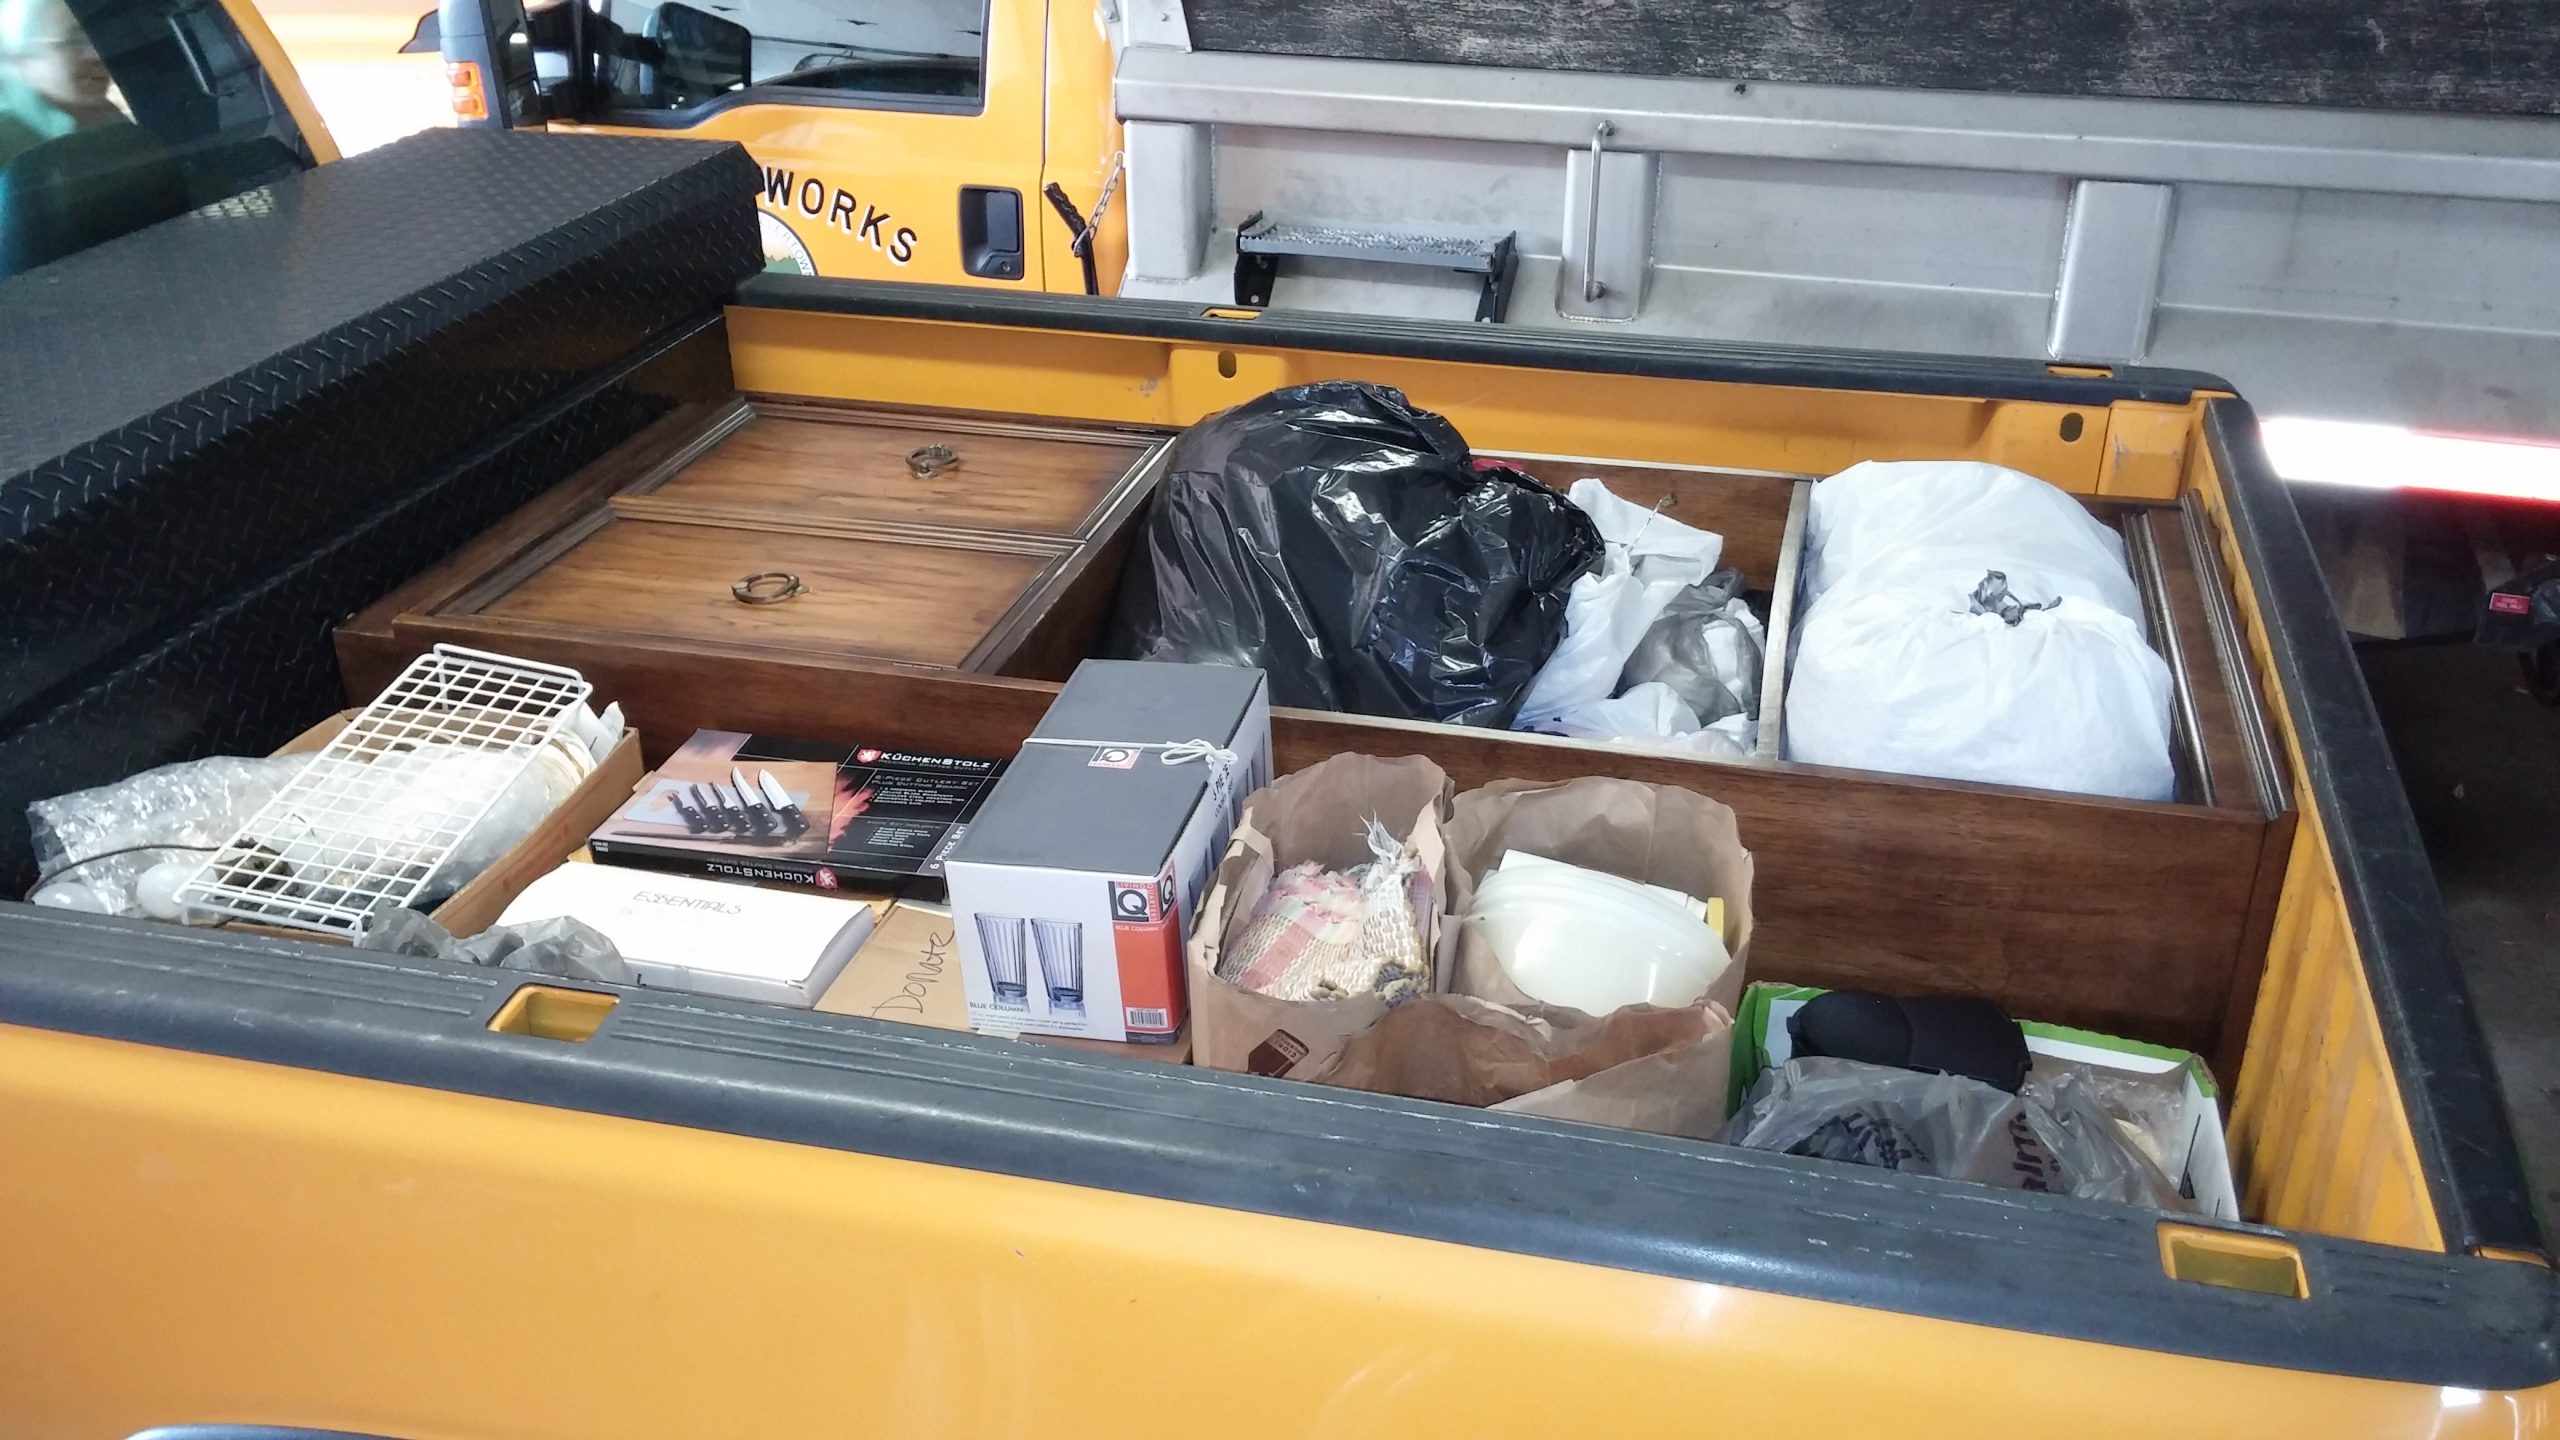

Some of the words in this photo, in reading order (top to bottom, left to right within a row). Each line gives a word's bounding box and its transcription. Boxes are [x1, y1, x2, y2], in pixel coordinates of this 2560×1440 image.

[764, 166, 918, 266] WORKS
[930, 862, 940, 870] 6
[935, 841, 957, 861] PIECE
[951, 826, 967, 840] SET
[632, 891, 742, 915] ESSENTIALS
[871, 929, 955, 1018] Donate
